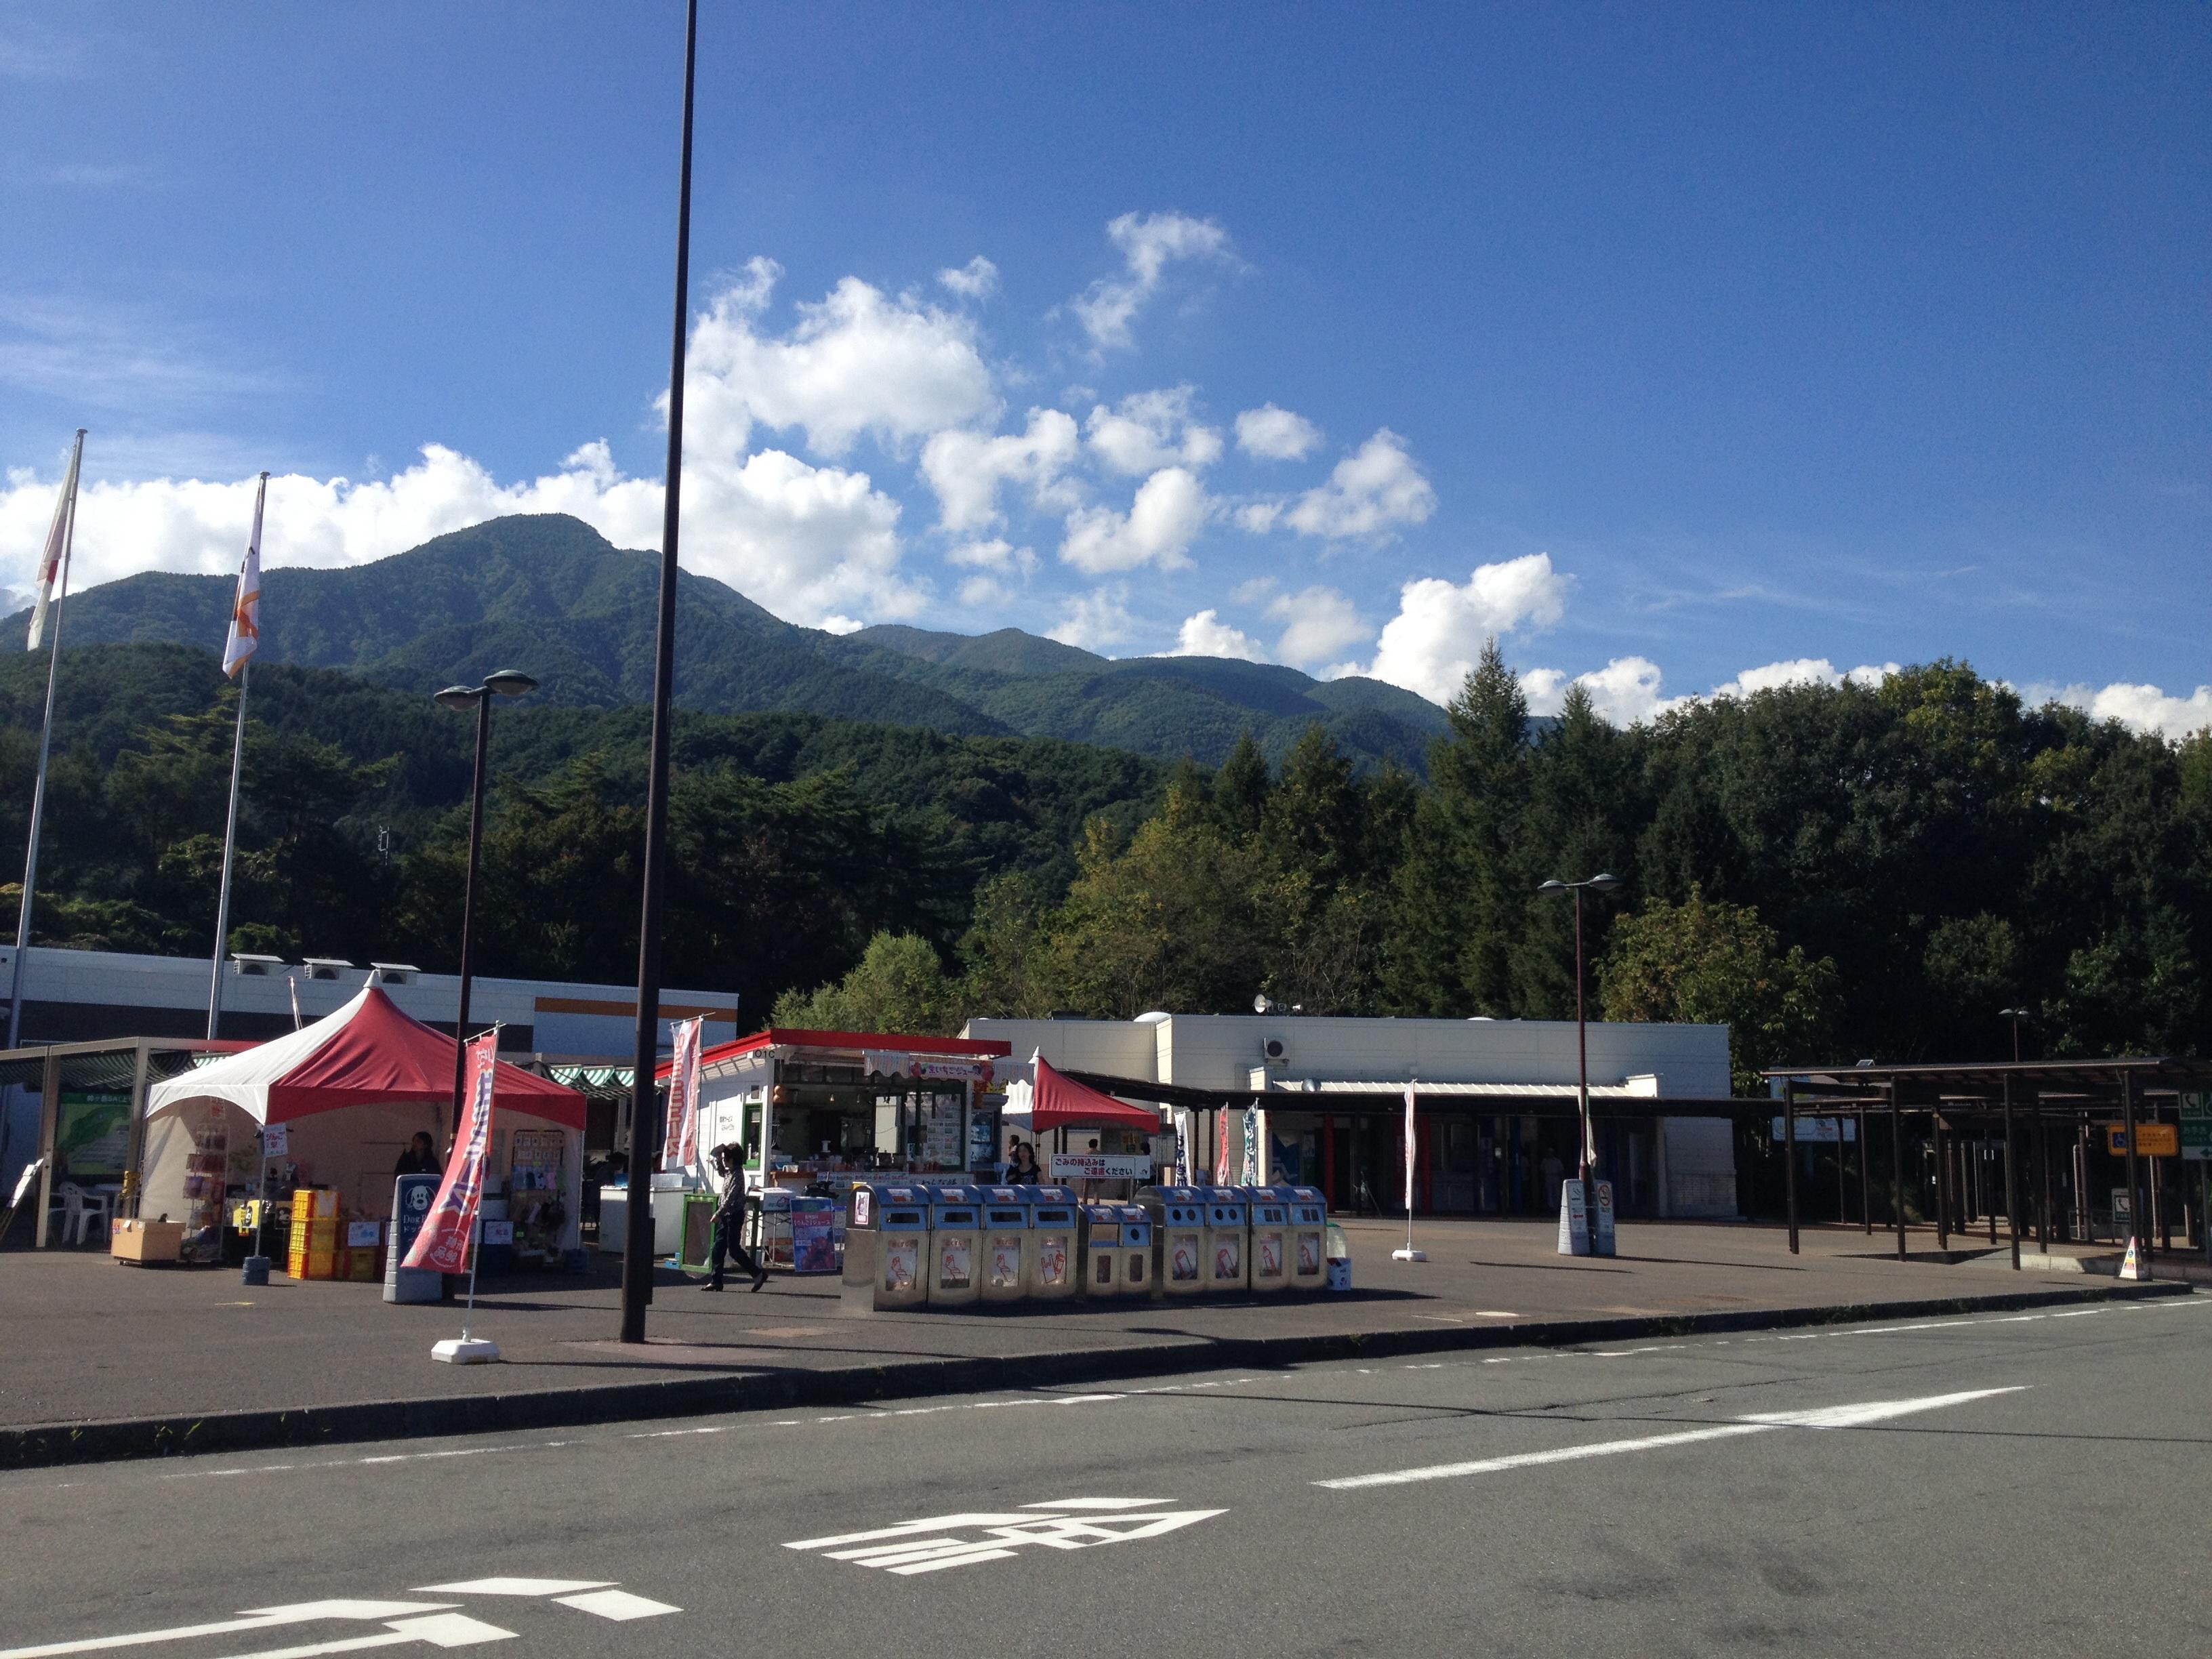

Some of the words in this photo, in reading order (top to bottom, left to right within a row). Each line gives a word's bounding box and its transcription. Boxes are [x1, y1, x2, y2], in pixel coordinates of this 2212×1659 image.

[1055, 1158, 1106, 1166] ごみの持込みは
[1084, 1167, 1132, 1175] ご遠慮ください
